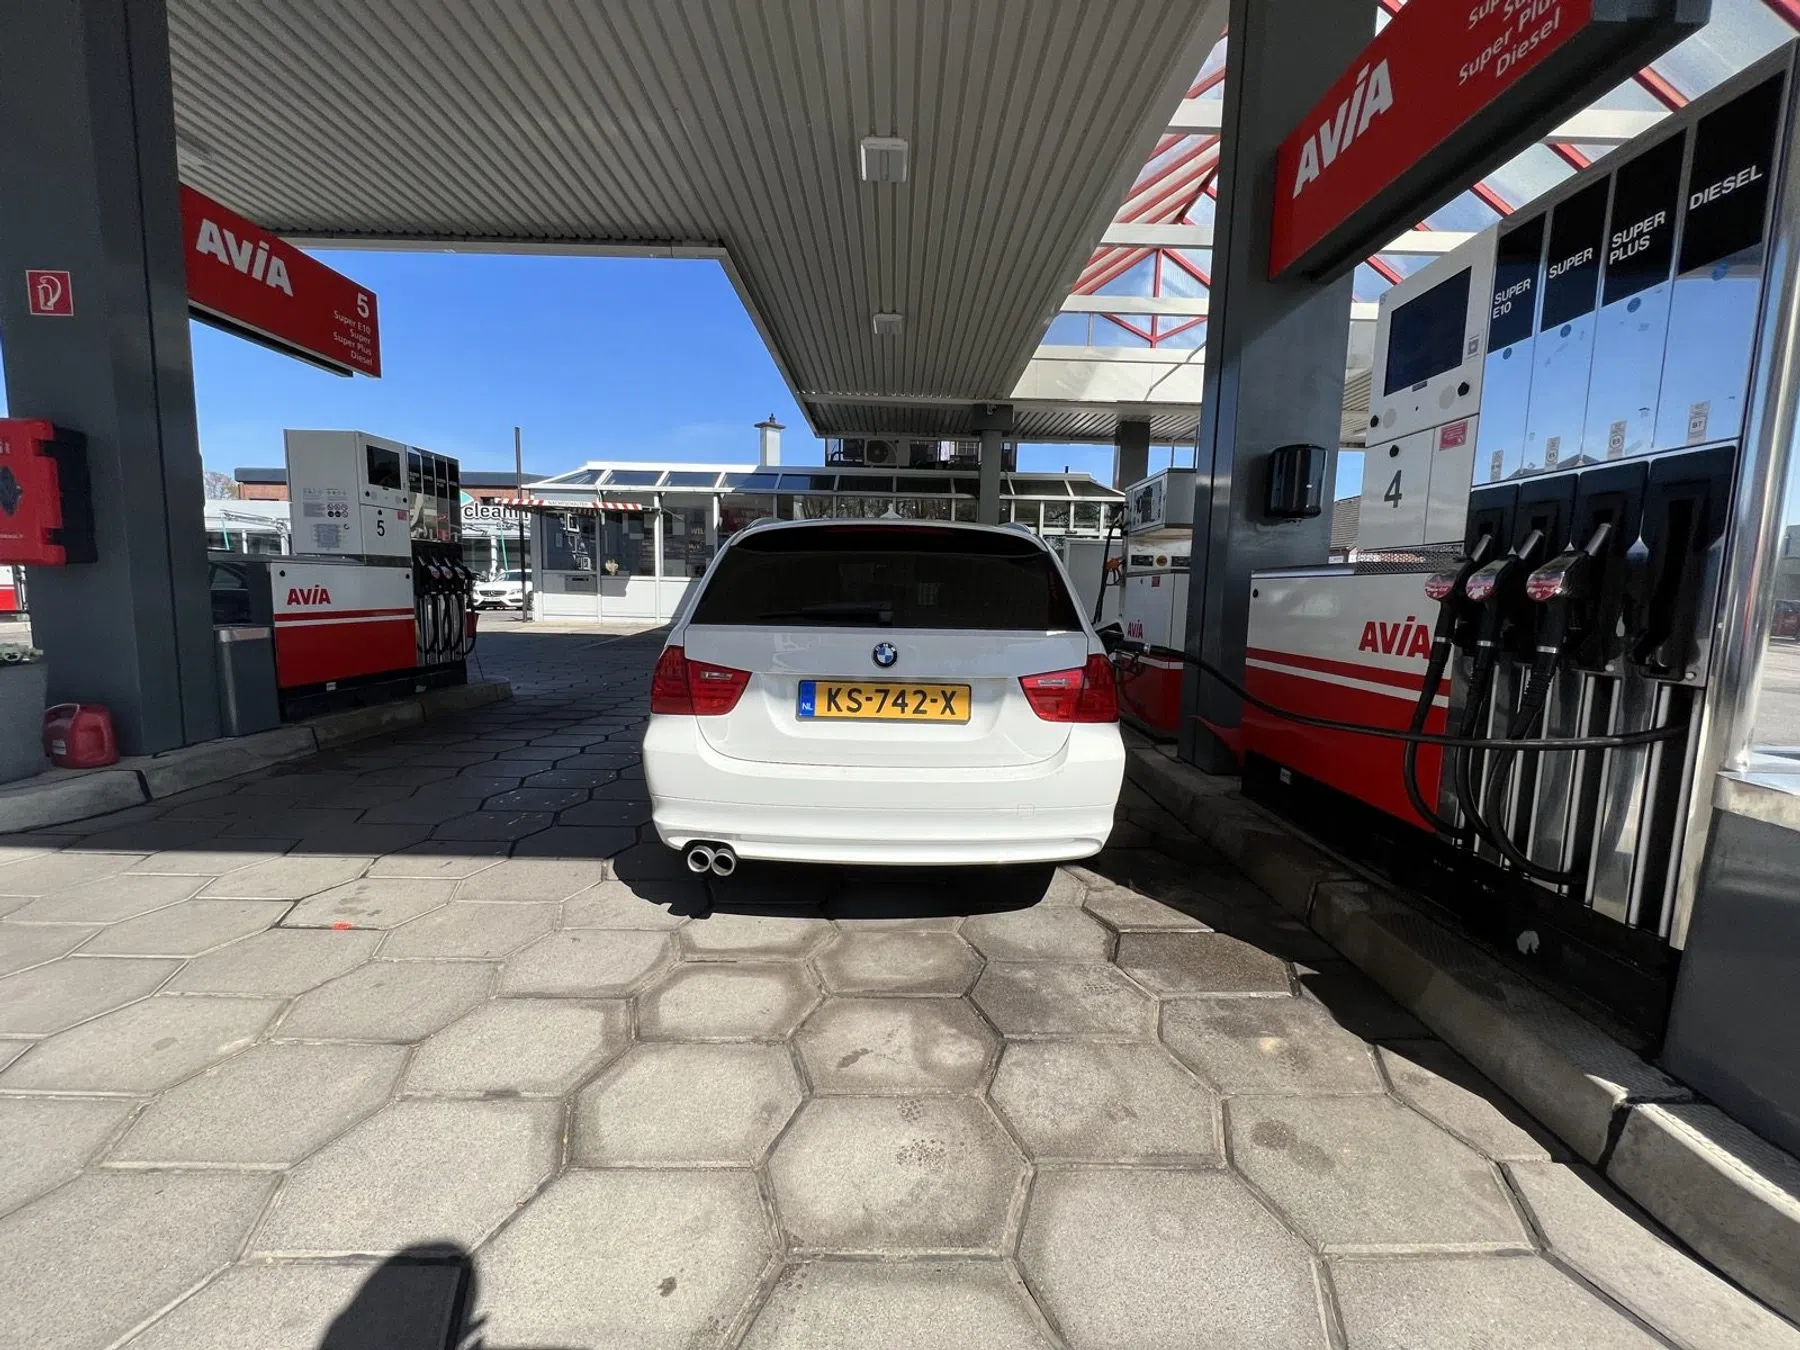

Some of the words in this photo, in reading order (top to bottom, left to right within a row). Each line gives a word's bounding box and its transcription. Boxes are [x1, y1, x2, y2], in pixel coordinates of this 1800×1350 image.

[1459, 27, 1513, 86] Super
[1518, 0, 1557, 32] Plu
[1496, 7, 1560, 77] Diesel
[1689, 165, 1763, 210] DIESEL
[1611, 211, 1666, 248] SUPER
[1548, 247, 1593, 279] SUPER
[1609, 235, 1650, 265] PLUS
[357, 292, 369, 318] 5
[1494, 278, 1531, 305] SUPER
[333, 310, 356, 327] Super
[357, 322, 371, 334] E10
[1492, 301, 1512, 319] E10
[1384, 469, 1402, 509] 4
[376, 520, 386, 537] 5
[801, 702, 814, 711] NL
[826, 687, 957, 716] KS-742-X
